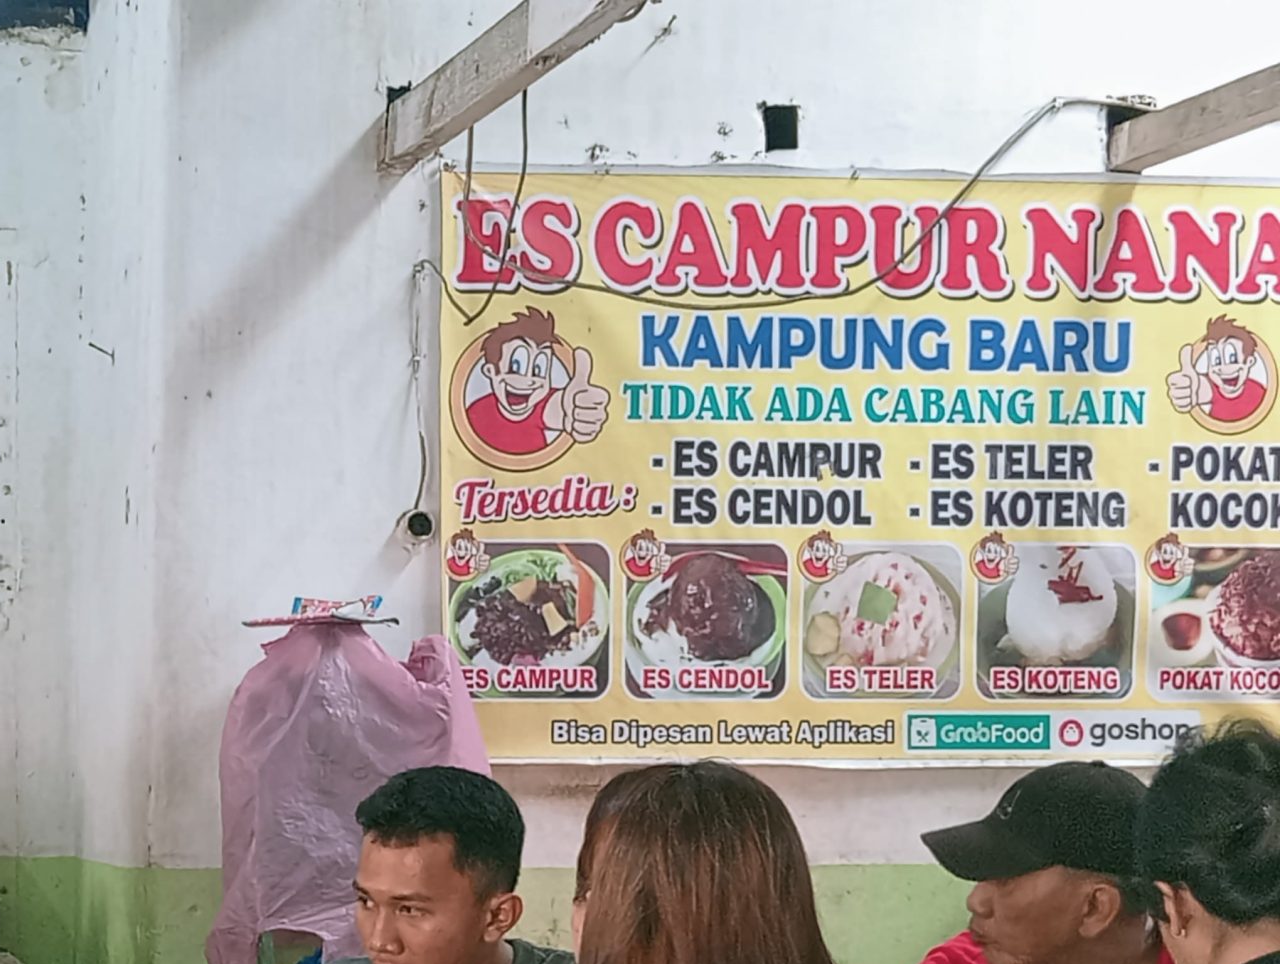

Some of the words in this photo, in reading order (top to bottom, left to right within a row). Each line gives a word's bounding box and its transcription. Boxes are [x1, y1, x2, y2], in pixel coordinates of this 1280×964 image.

[455, 198, 577, 288] ES
[592, 199, 1010, 293] CAMPUR
[1023, 205, 1280, 296] NANA
[640, 314, 951, 371] KAMPUNG
[968, 318, 1132, 374] BARU
[622, 382, 753, 421] TIDAK
[764, 384, 852, 423] ADA
[865, 386, 1034, 425] CABANG
[1048, 389, 1146, 426] LAIN
[673, 440, 718, 477] ES
[728, 440, 882, 479] CAMPUR
[930, 443, 975, 479] ES
[985, 444, 1093, 480] TELER
[672, 488, 718, 525] ES
[728, 488, 872, 526] CENDOL
[930, 490, 974, 527] ES
[984, 491, 1126, 529] KOTENG
[461, 668, 489, 690] ES
[496, 668, 595, 690] CAMPUR
[642, 668, 671, 690] ES
[677, 668, 770, 690] CENDOL
[828, 668, 856, 690] ES
[862, 668, 935, 690] TELER
[992, 668, 1020, 691] ES
[1027, 668, 1119, 691] KOTENG
[1159, 669, 1224, 690] POKAT
[552, 721, 606, 744] Bisa
[612, 721, 713, 747] Dipesan
[719, 722, 792, 744] Lewat
[796, 721, 896, 748] Aplikasi
[939, 722, 1045, 745] GrabFood
